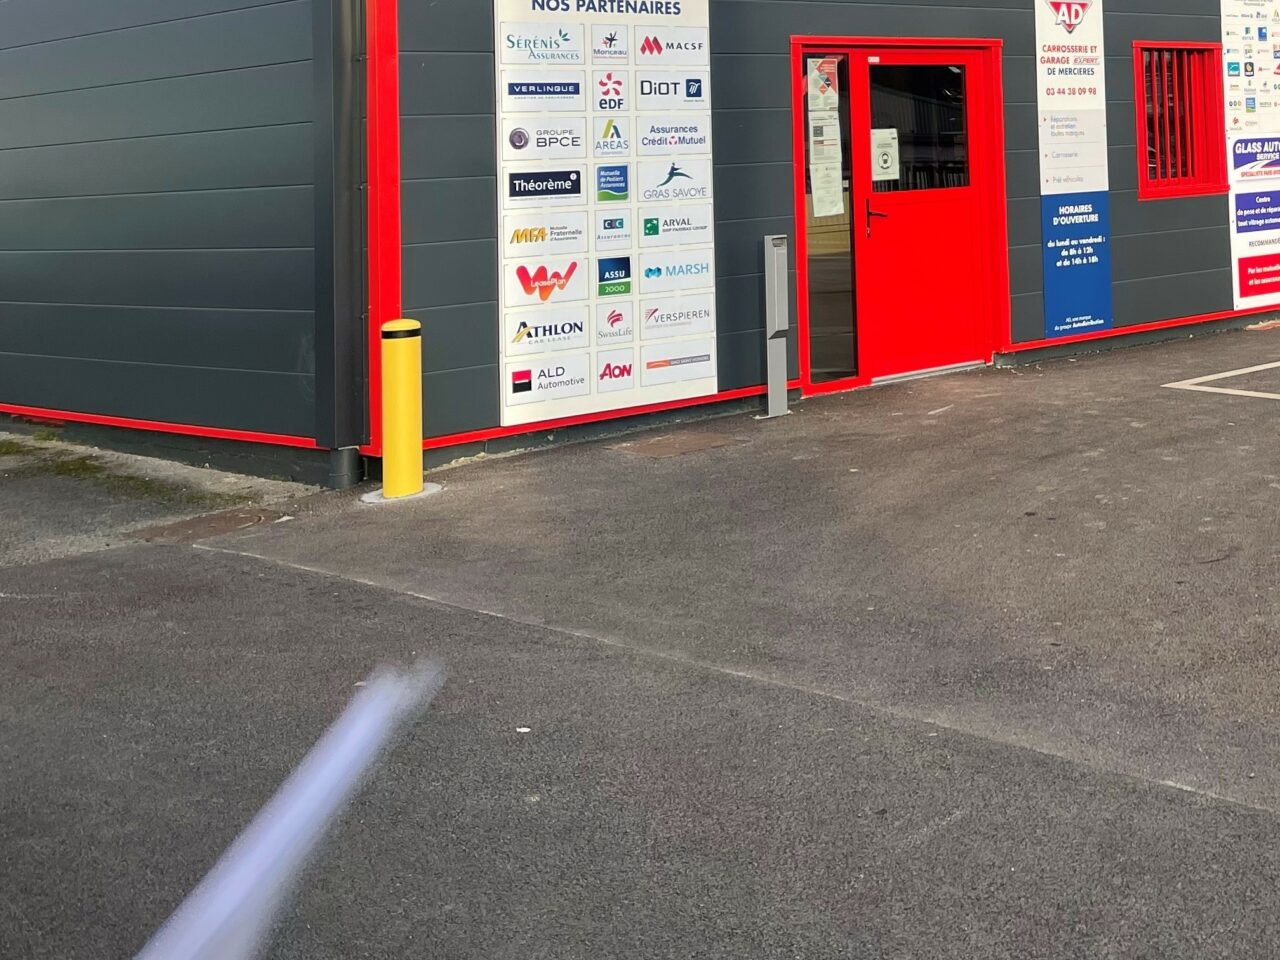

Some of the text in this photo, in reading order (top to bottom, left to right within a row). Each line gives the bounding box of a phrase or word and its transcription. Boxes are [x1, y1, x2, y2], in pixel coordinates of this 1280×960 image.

[576, 0, 681, 15] PARTENAIRES
[1056, 3, 1083, 25] AD
[593, 48, 627, 56] Monceau
[666, 42, 704, 51] MACSF
[1042, 44, 1097, 53] CARROSSERIE ET
[1040, 56, 1070, 64] GARAGE
[1047, 67, 1095, 75] DE MERCIERES
[1046, 87, 1055, 96] 03
[1078, 87, 1087, 95] 09
[1088, 87, 1097, 95] 98
[650, 125, 698, 134] Assurances
[536, 136, 581, 148] BPCE
[641, 136, 706, 146] Crédit Mutuel
[1235, 141, 1262, 154] GLASS
[1256, 152, 1280, 160] SERVICE
[513, 178, 572, 192] Théorème
[643, 187, 707, 200] GRAS SAVOYE
[1059, 204, 1093, 214] HORAIRES
[662, 218, 692, 227] ARVAL
[1052, 213, 1099, 225] D'OUVERTURE
[510, 226, 548, 244] MFA
[604, 271, 625, 279] ASSU
[665, 263, 709, 276] MARSH
[605, 285, 625, 293] 2000
[654, 309, 710, 323] VERSPIEREN
[514, 321, 583, 340] ATHLON
[538, 366, 565, 379] ALD
[538, 377, 585, 390] Automotive
